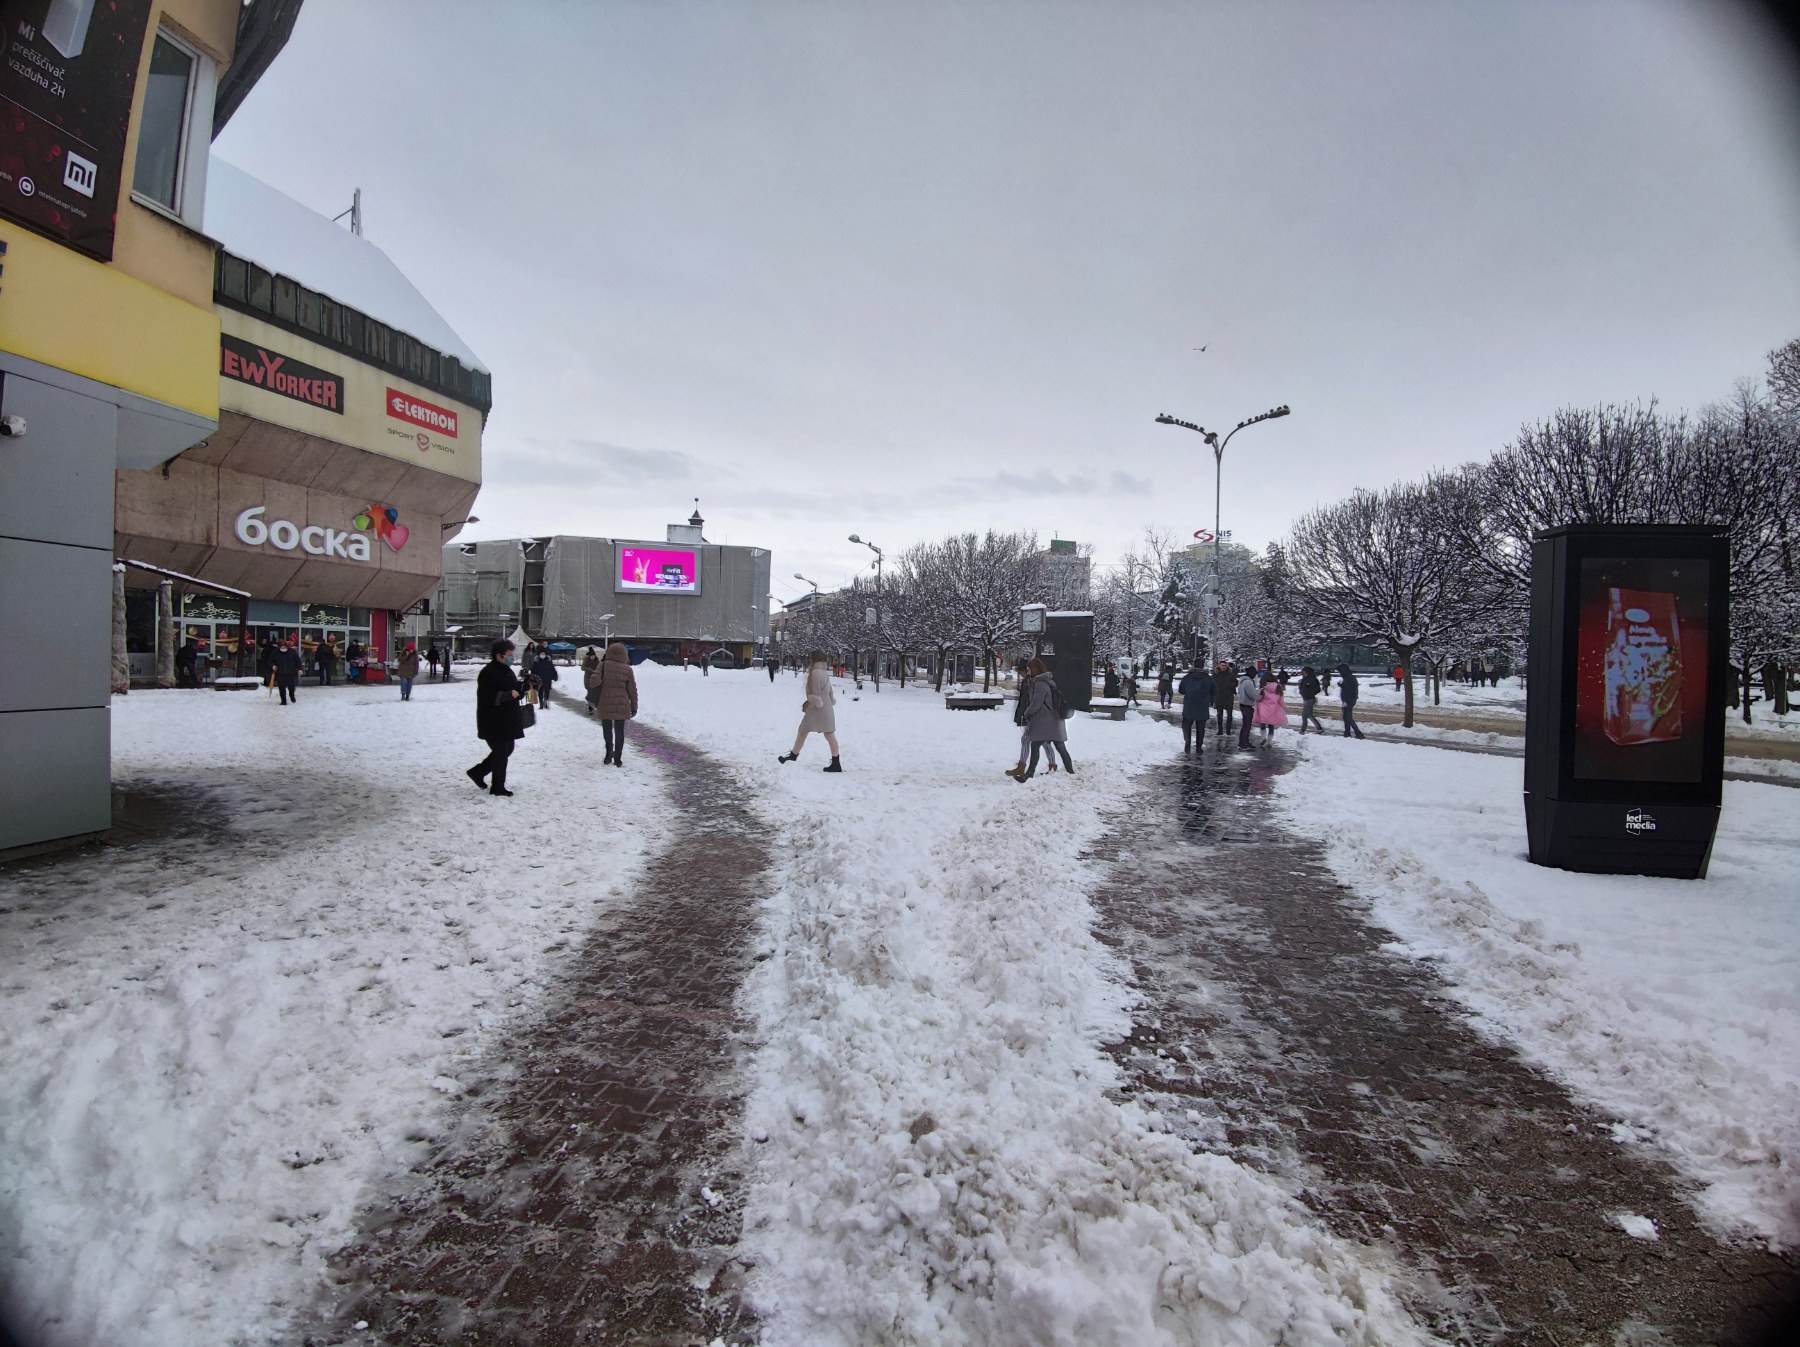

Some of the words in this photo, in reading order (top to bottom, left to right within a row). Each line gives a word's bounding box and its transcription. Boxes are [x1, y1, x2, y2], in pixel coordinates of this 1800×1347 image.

[18, 20, 36, 41] Mi
[8, 56, 49, 89] vazduha
[50, 81, 66, 99] 2H
[224, 349, 337, 409] EWYORKER
[391, 397, 456, 432] ELEKTRON
[235, 505, 370, 561] боска
[1626, 814, 1641, 822] led
[1626, 821, 1656, 829] media
